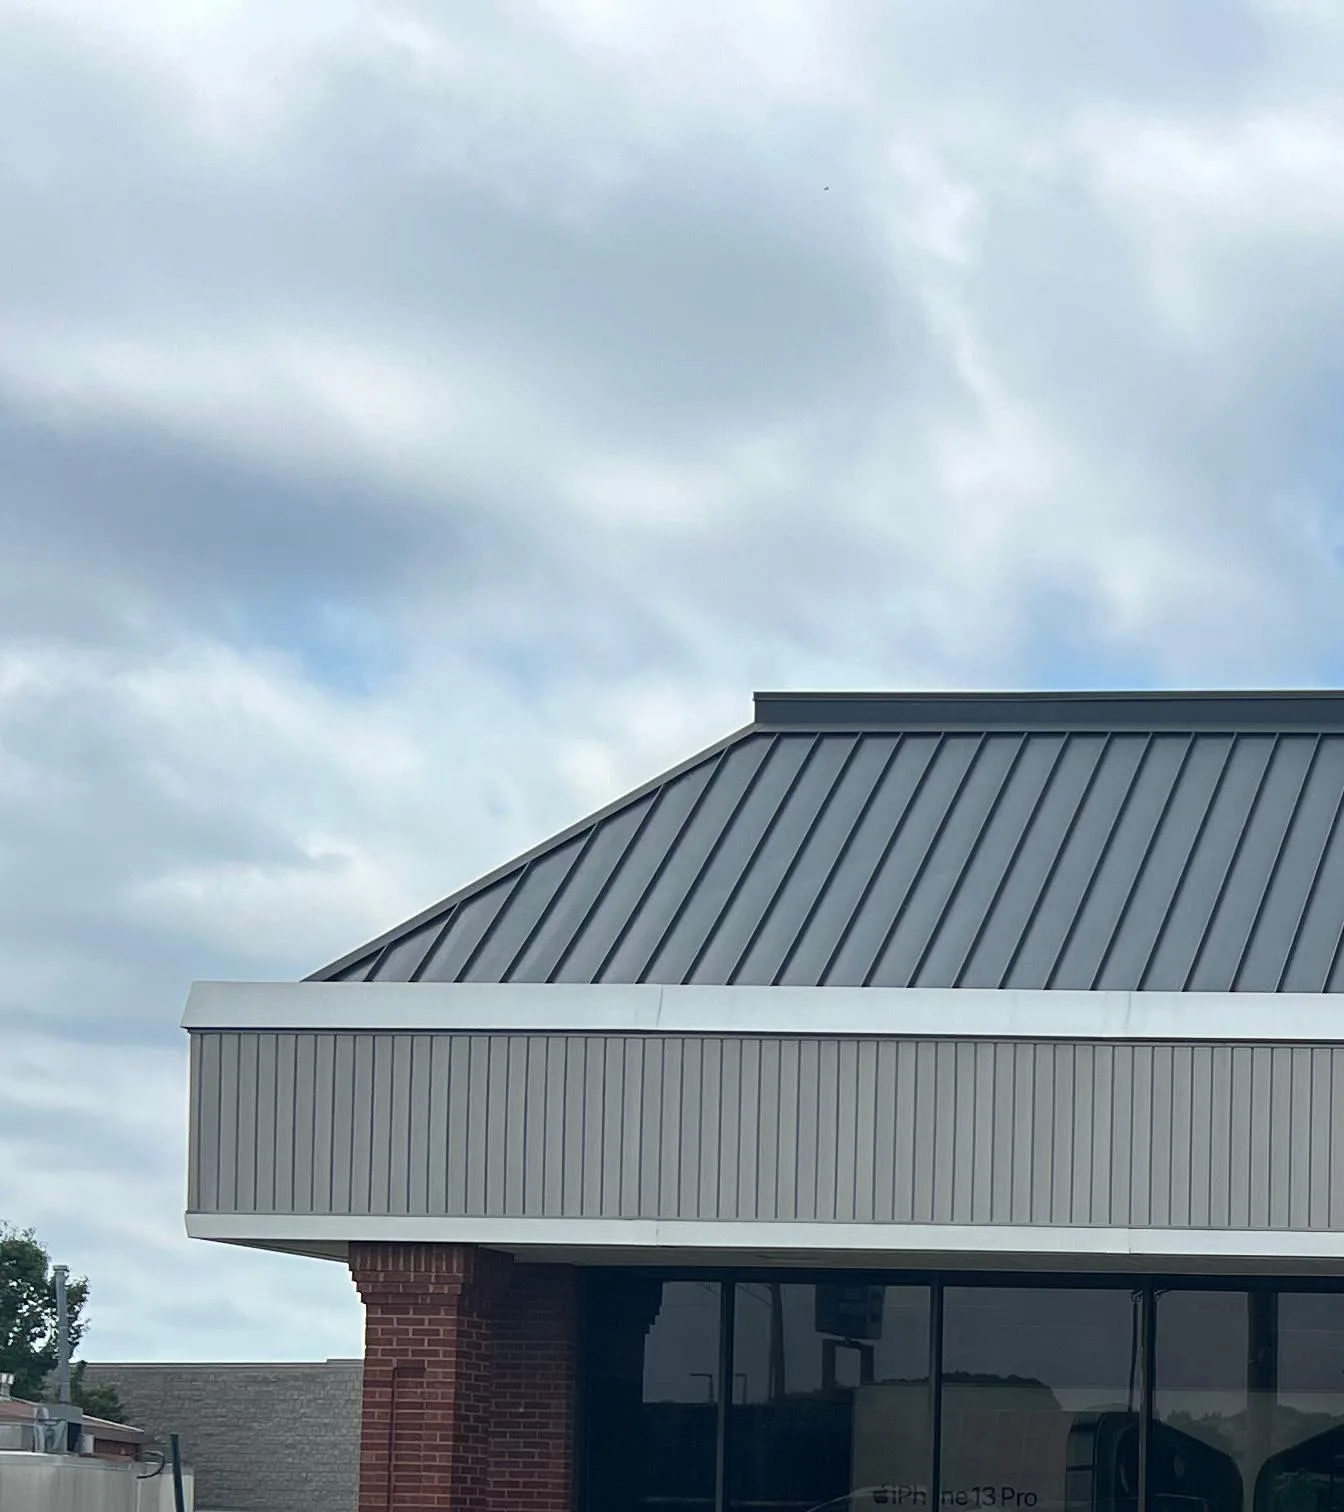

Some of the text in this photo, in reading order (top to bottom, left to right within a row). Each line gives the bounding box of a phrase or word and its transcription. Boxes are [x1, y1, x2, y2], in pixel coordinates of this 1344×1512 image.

[891, 1485, 1038, 1508] iPhne 13 Pro
